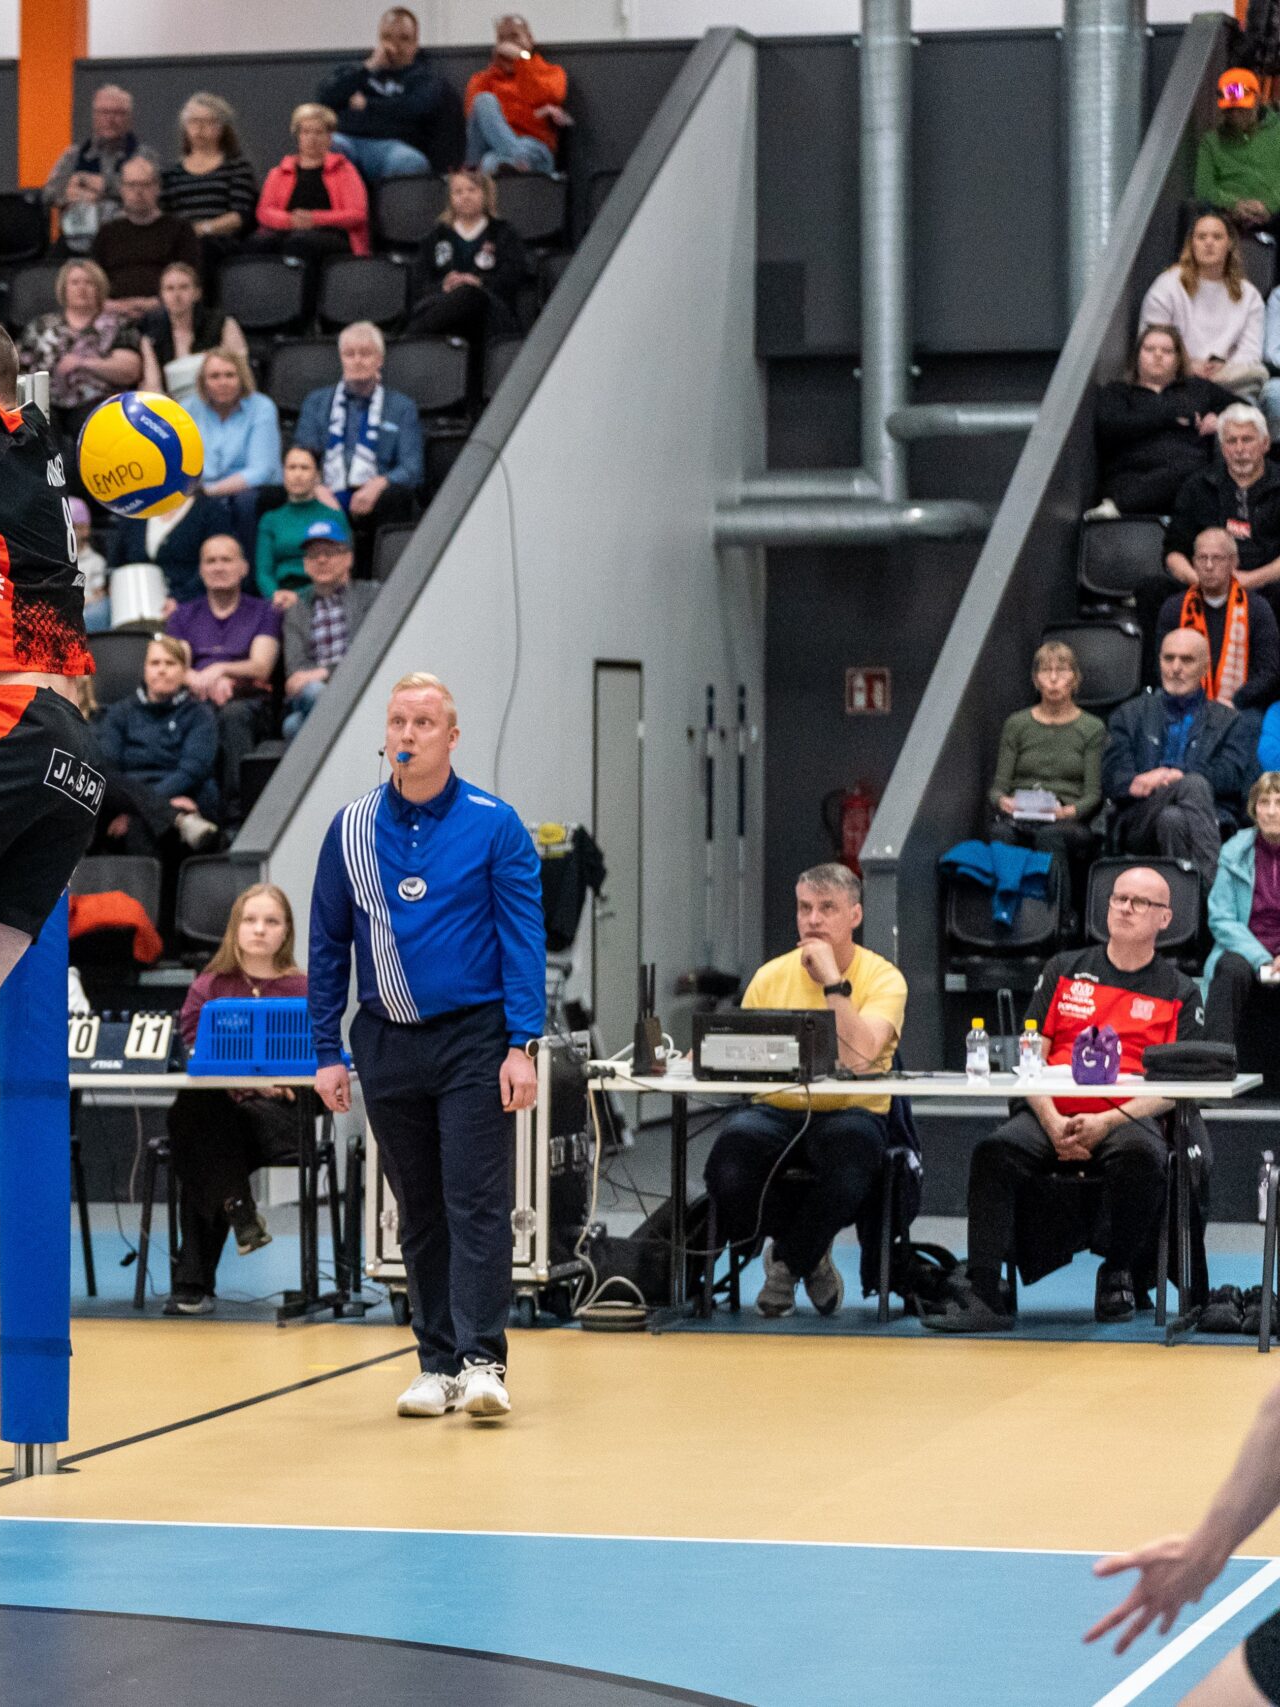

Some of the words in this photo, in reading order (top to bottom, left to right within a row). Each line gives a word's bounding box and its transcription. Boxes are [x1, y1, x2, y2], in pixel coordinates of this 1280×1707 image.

[87, 461, 144, 495] LEMPO
[68, 1022, 94, 1054] 0
[135, 1021, 164, 1054] 11
